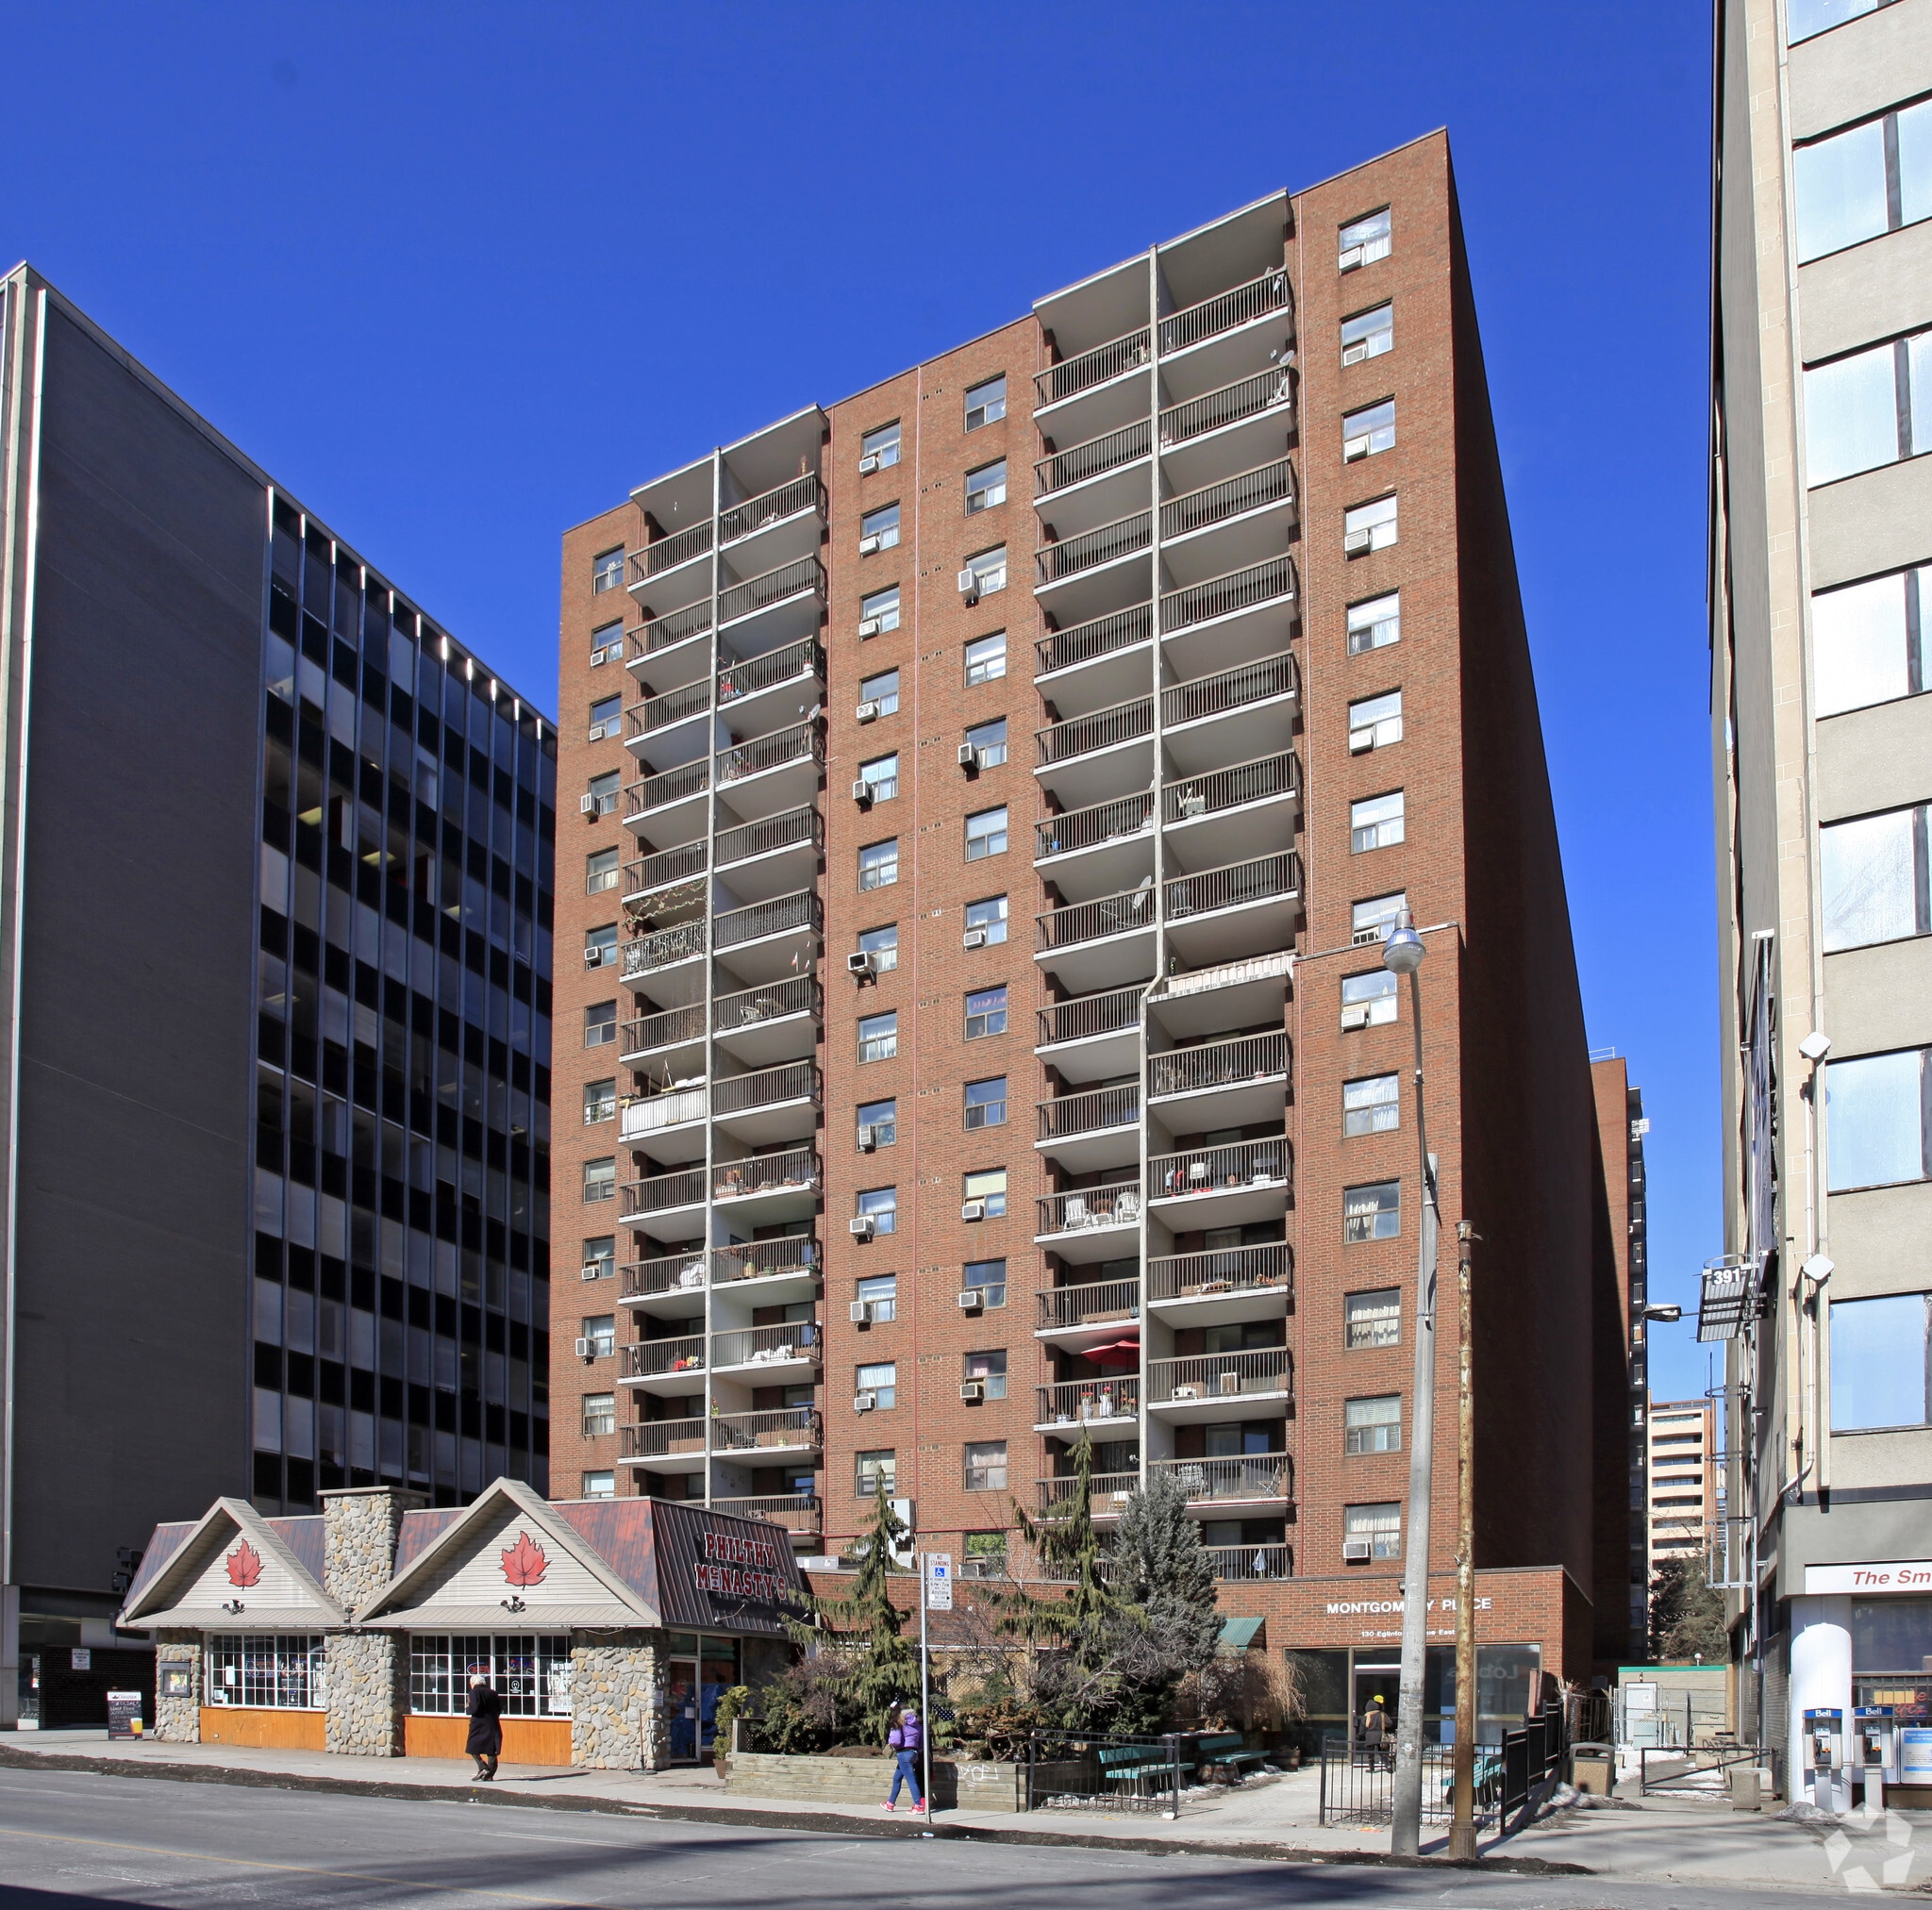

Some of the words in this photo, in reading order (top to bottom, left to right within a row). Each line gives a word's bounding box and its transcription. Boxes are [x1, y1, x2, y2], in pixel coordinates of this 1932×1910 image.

[1713, 1268, 1740, 1285] 391
[705, 1532, 774, 1568] PHILTHY
[1853, 1571, 1890, 1586] The
[1897, 1570, 1932, 1585] Sm
[1327, 1600, 1434, 1613] MONTGOMY
[1442, 1598, 1491, 1611] PLCE
[1377, 1630, 1403, 1638] Eglinto
